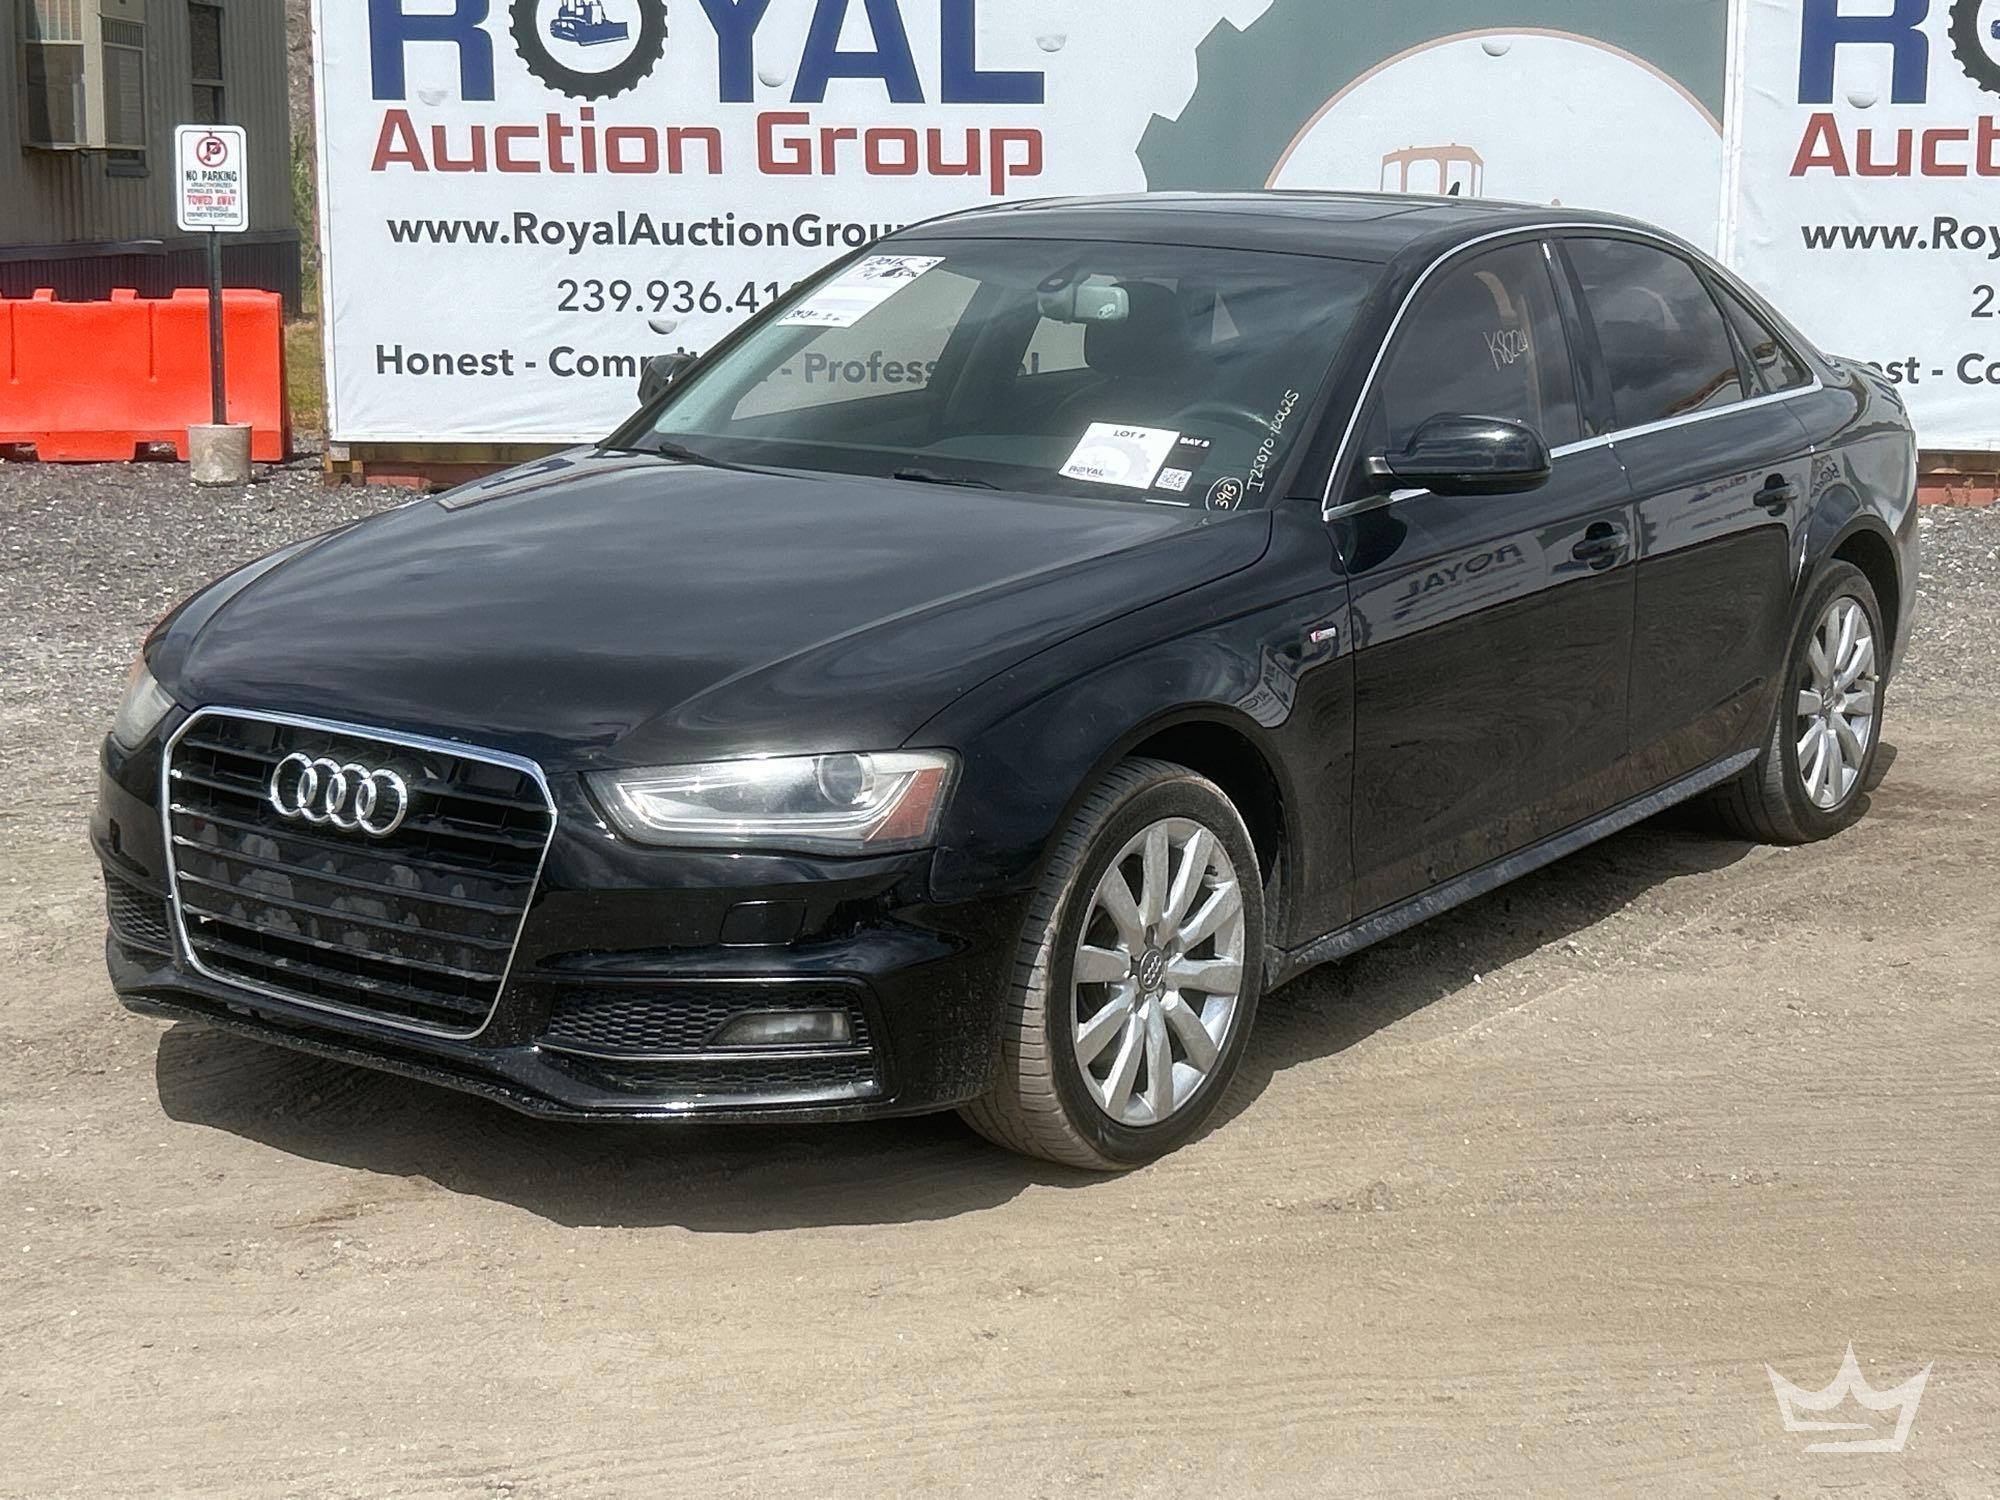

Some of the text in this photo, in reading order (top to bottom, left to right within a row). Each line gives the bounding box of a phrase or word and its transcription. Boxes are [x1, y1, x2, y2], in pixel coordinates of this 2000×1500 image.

[369, 0, 1045, 104] ROYAL
[371, 107, 1042, 195] Auction Group
[1789, 113, 2000, 177] Auct
[186, 171, 237, 182] NO PARKING
[187, 195, 236, 206] TOWED AWAY
[387, 210, 904, 254] www.RoyalAuctionGrou
[557, 279, 785, 313] 239.936.41
[1971, 285, 2000, 318] 2
[376, 345, 514, 376] Honest
[1113, 430, 1136, 438] LOT
